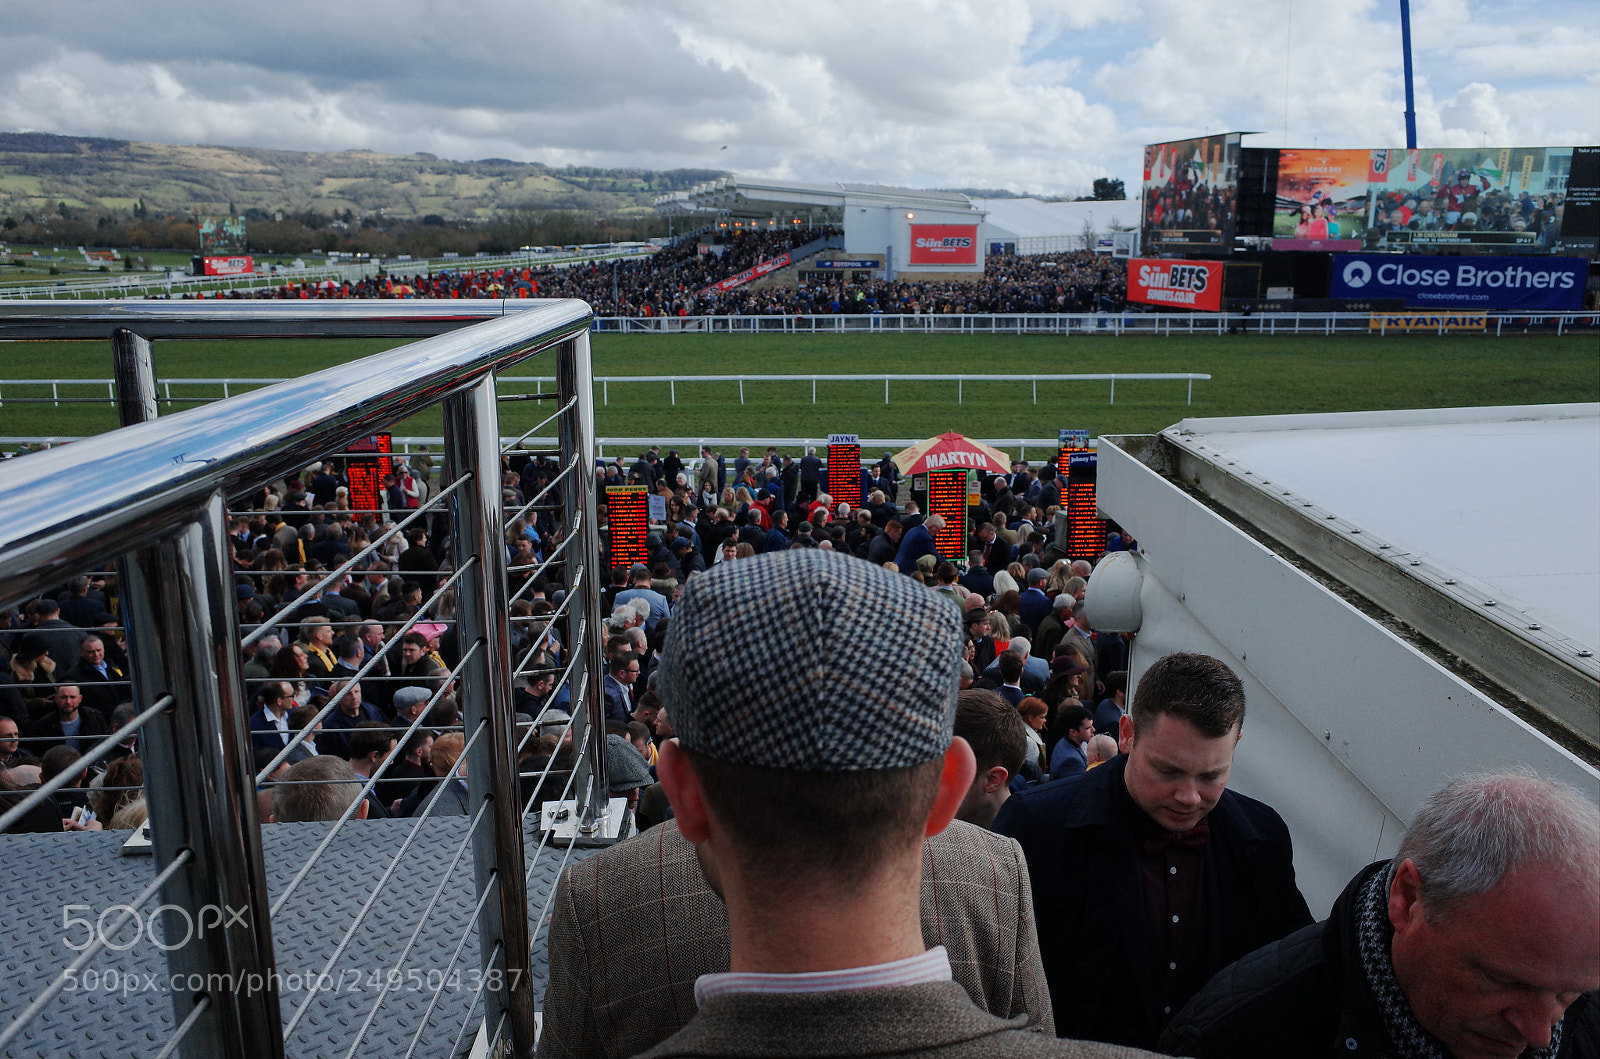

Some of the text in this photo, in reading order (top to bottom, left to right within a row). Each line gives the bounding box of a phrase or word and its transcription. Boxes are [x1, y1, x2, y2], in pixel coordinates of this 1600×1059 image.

[1377, 263, 1575, 289] Close Brothers
[1417, 292, 1489, 301] closebrothers.com
[1387, 314, 1483, 326] RYANAIR
[830, 435, 856, 443] JAYNE
[925, 451, 988, 468] MARTYN
